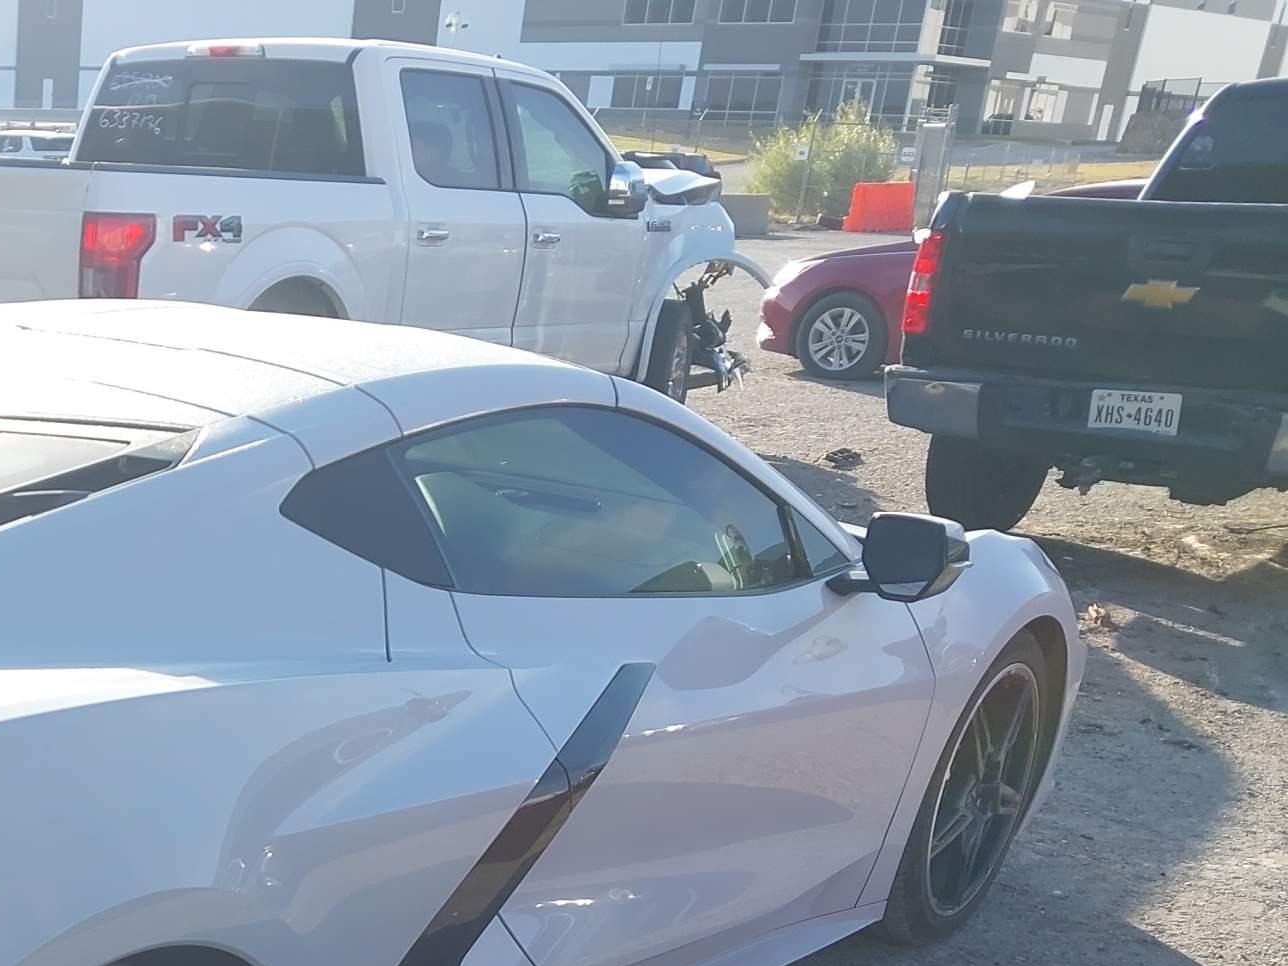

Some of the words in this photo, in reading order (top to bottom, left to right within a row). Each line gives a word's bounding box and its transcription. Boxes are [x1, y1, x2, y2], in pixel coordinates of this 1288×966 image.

[173, 215, 242, 241] FX4
[962, 329, 1078, 347] SILVERADO
[1120, 393, 1154, 404] TEXAS
